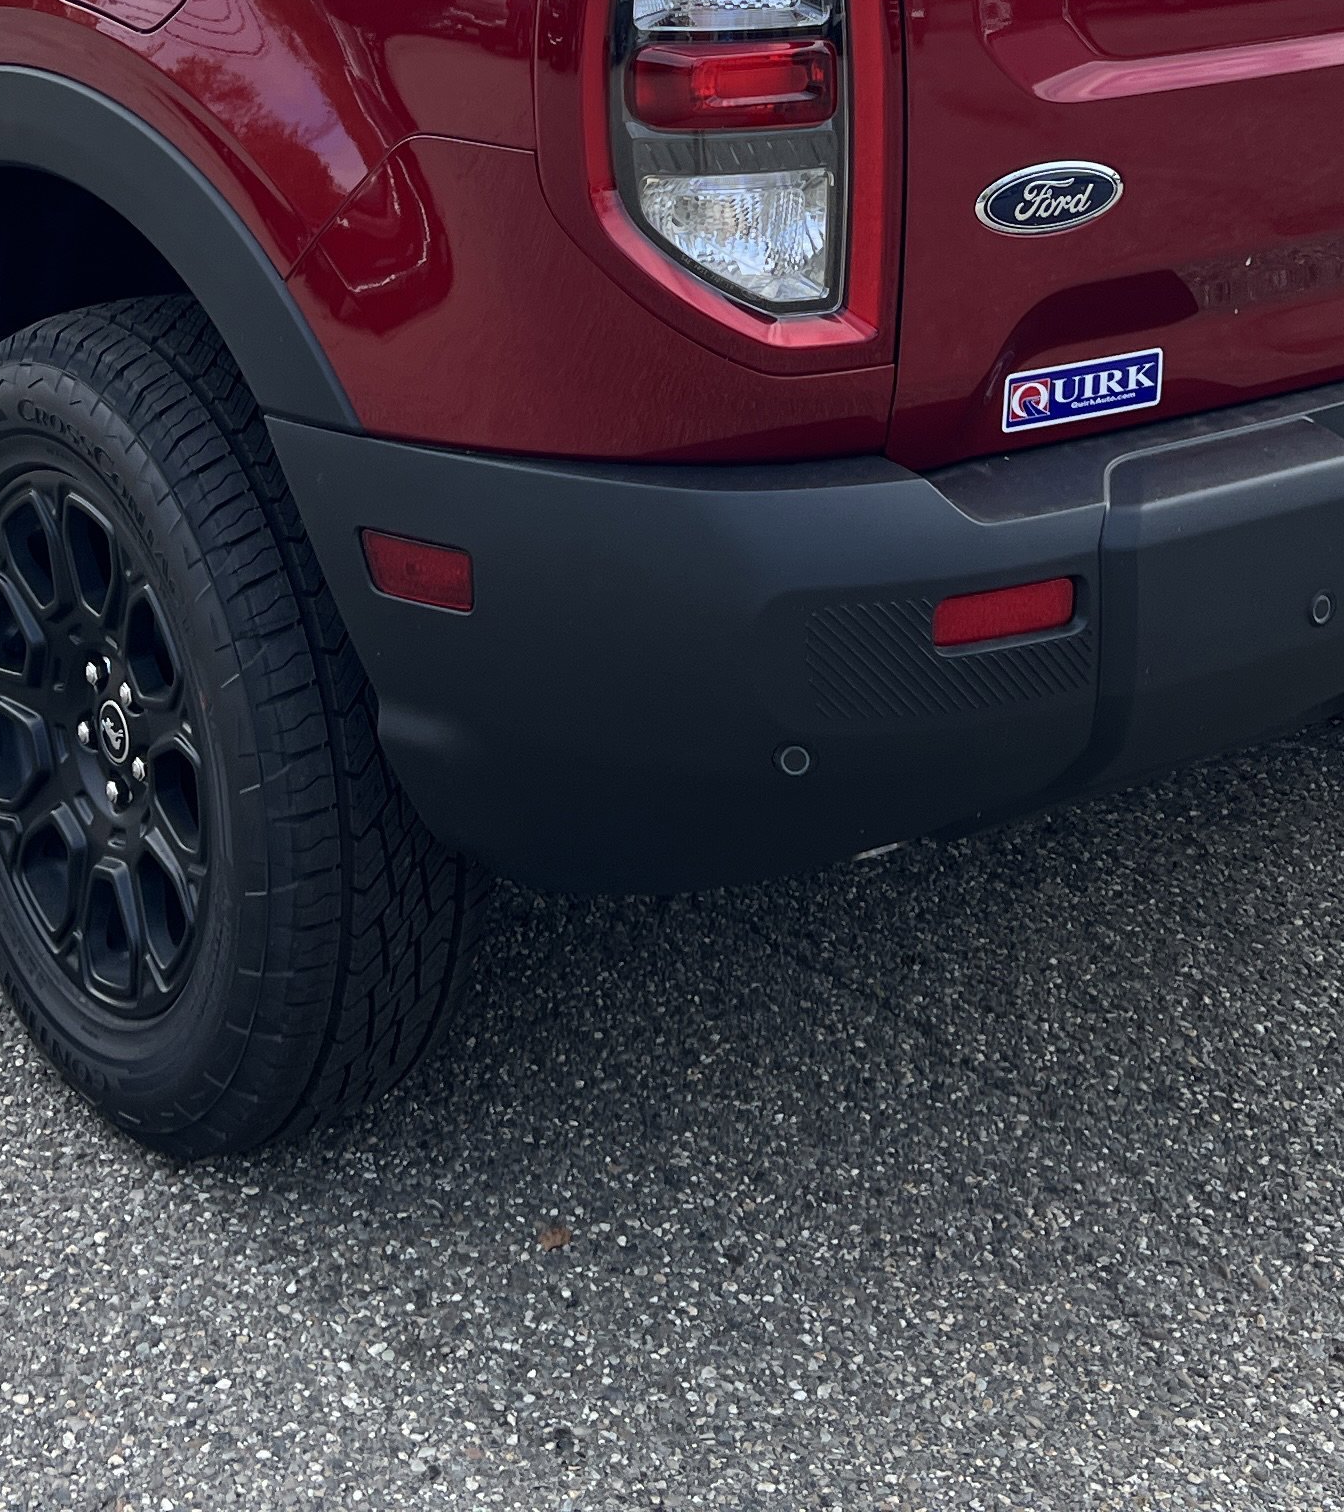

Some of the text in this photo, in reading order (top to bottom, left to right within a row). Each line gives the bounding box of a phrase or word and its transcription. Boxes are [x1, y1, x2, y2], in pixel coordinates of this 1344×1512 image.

[1014, 177, 1094, 222] Ford
[1010, 361, 1156, 420] QUIRK
[1070, 391, 1136, 409] QuirkAuto.com
